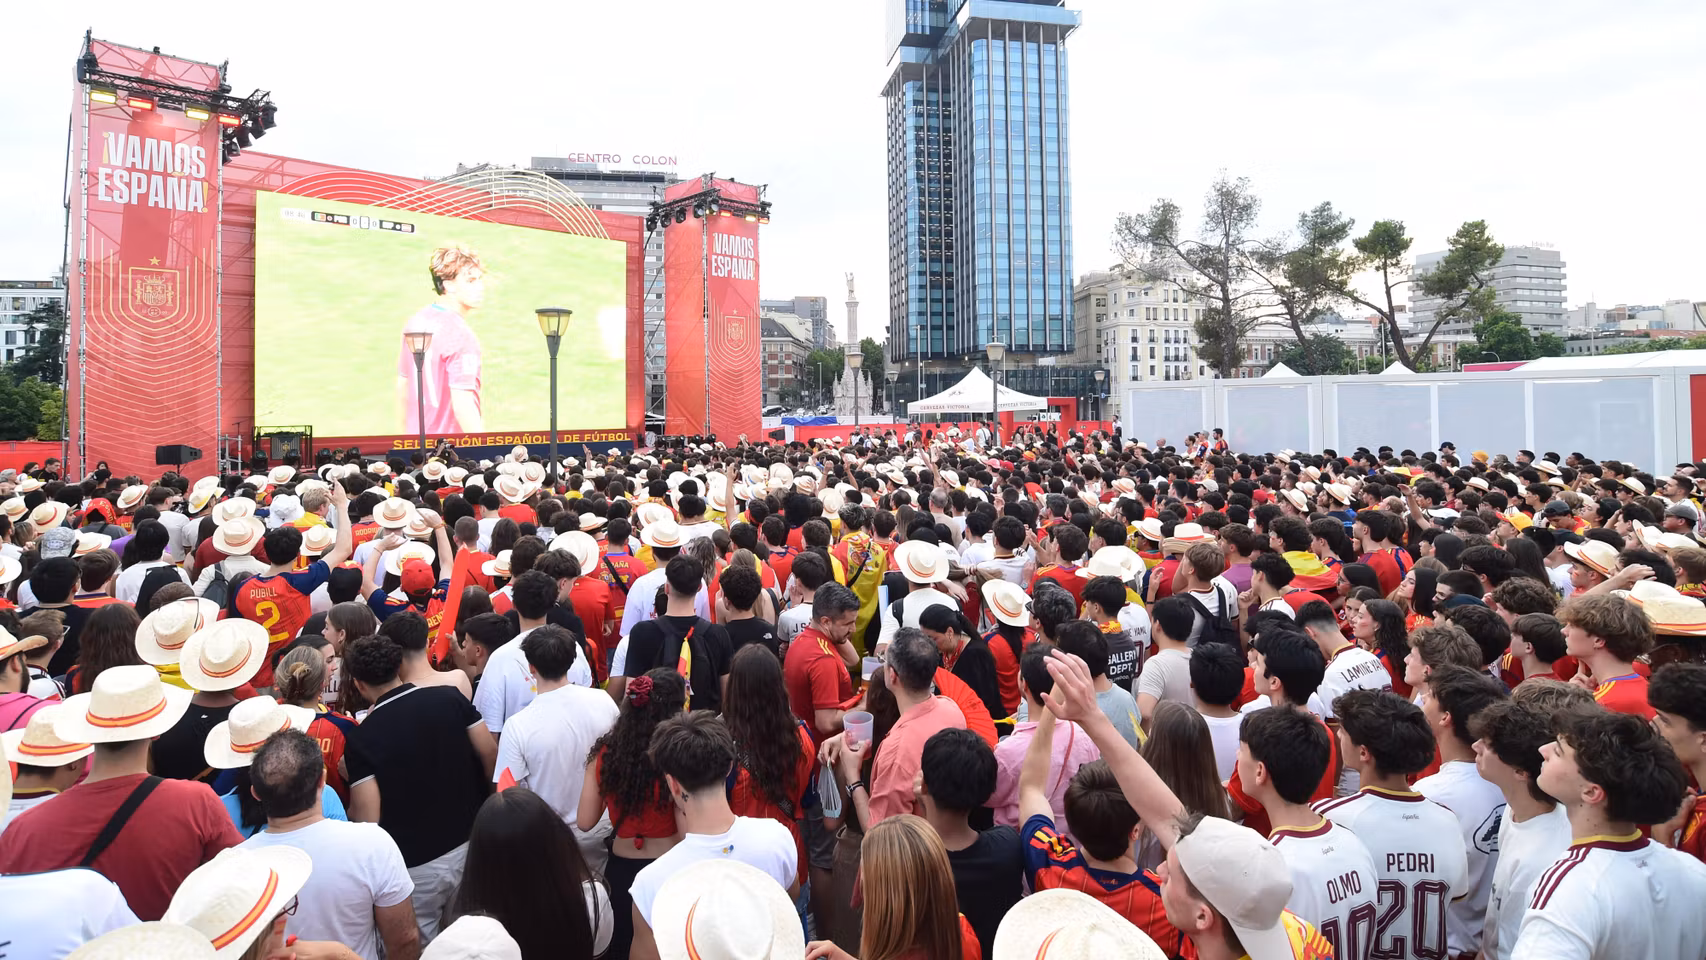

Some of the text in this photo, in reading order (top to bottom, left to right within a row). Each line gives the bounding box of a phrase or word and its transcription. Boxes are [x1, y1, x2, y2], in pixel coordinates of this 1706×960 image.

[568, 152, 677, 166] CENTRO COLON
[486, 433, 560, 446] ESPAÑOL
[563, 434, 580, 443] DE
[584, 431, 631, 442] FÚTBOL
[600, 561, 629, 569] ESAÑA
[250, 587, 277, 599] PUBILL
[256, 600, 290, 644] 2
[1109, 662, 1133, 676] DEPT.
[1341, 661, 1373, 683] LAMINE
[1386, 853, 1435, 873] PEDRI
[1326, 870, 1362, 904] OLMO
[1369, 878, 1450, 960] 20
